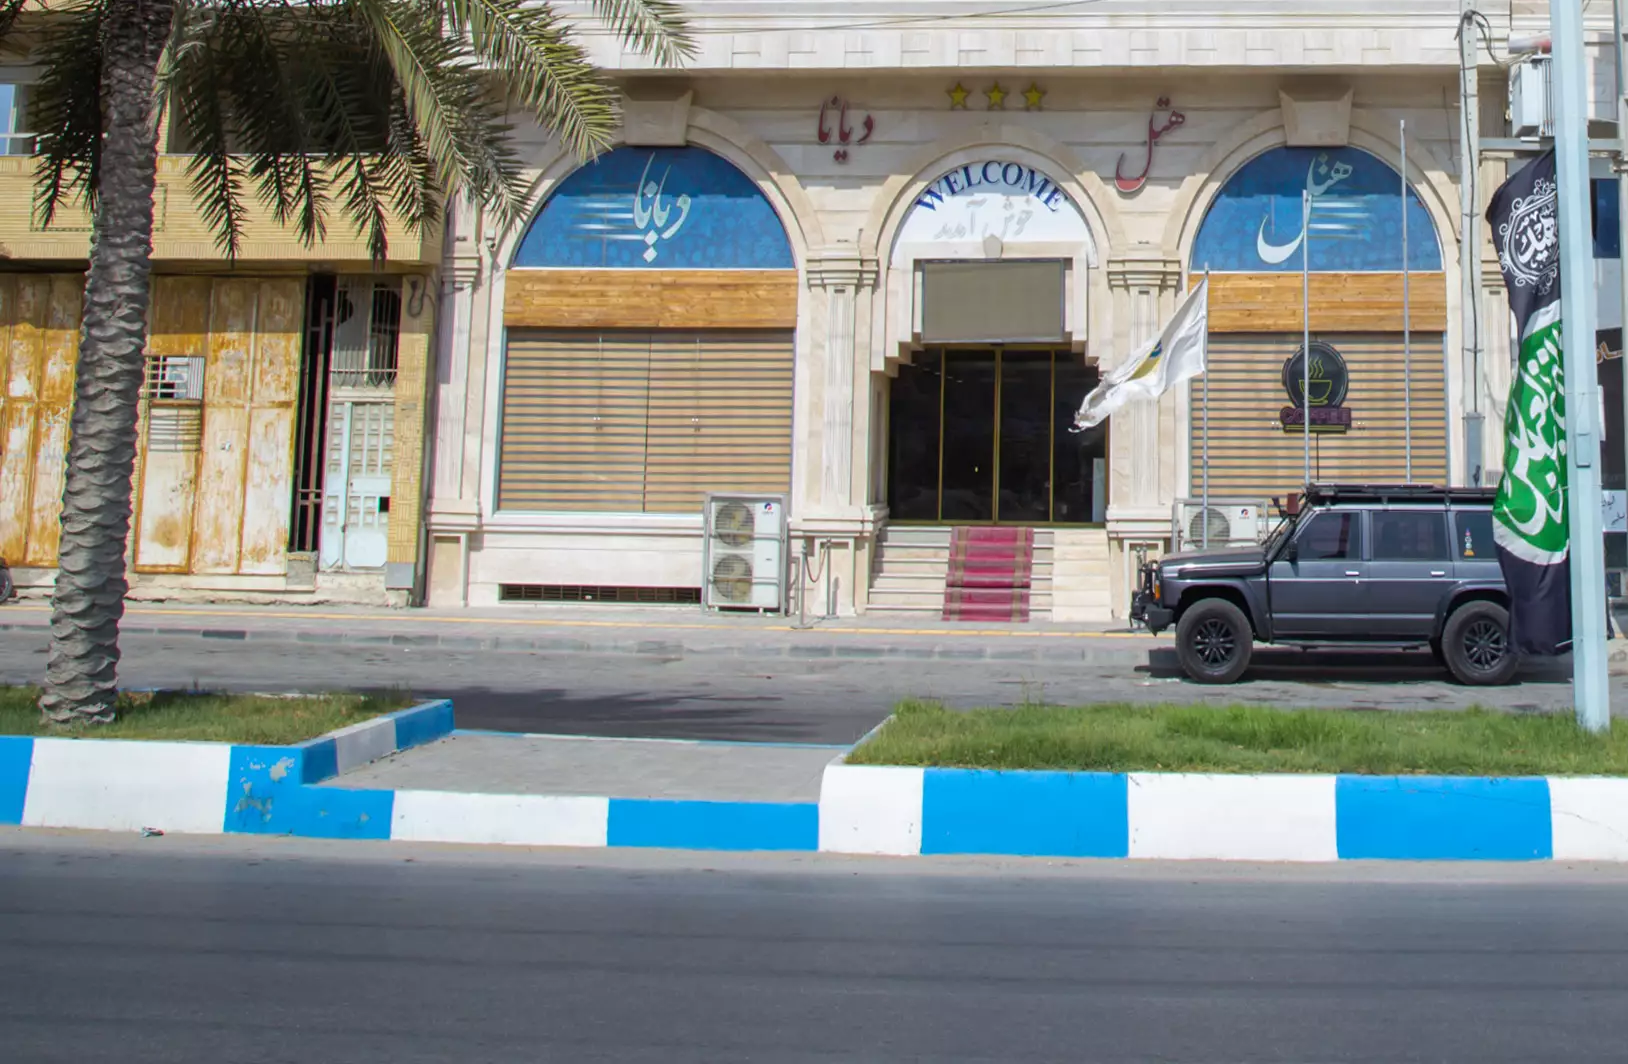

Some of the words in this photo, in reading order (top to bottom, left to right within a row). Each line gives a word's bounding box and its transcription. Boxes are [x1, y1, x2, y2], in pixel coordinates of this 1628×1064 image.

[816, 94, 876, 164] دیانا
[1114, 95, 1186, 193] هتل
[632, 151, 692, 264] دیانا
[914, 159, 1069, 213] WELCOME
[1256, 151, 1354, 265] هتل
[1280, 406, 1351, 424] COFFEE
